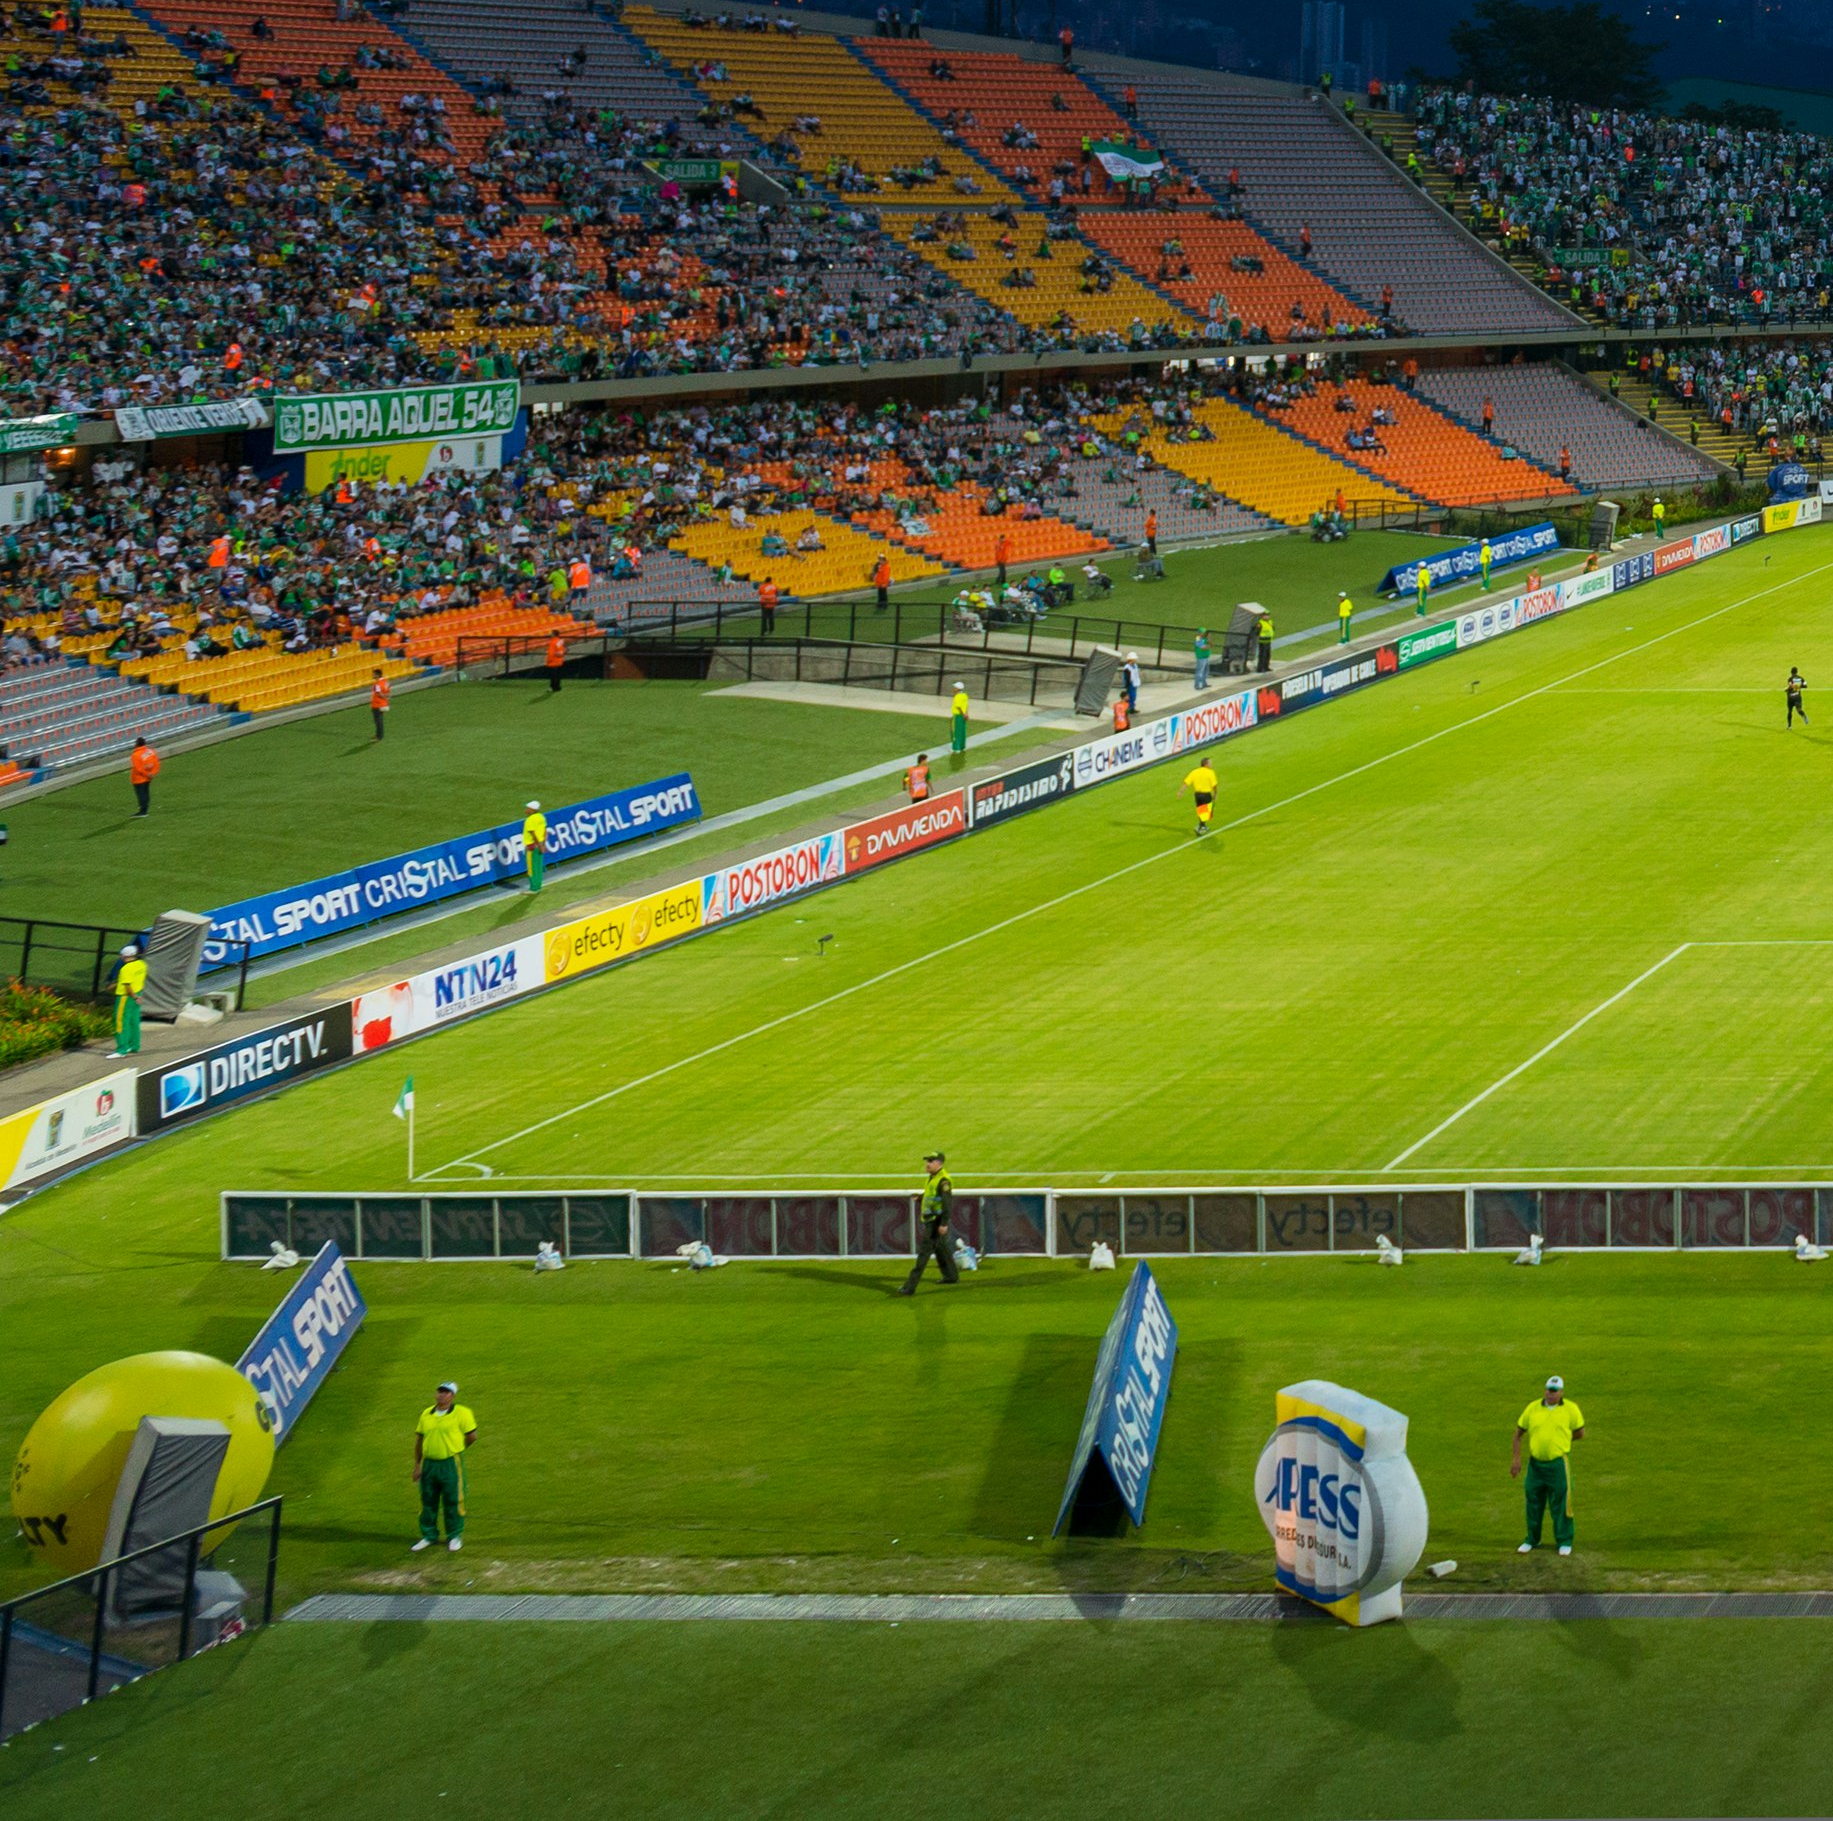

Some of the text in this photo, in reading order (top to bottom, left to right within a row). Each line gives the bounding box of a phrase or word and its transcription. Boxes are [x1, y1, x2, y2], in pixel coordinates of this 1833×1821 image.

[664, 163, 706, 177] SALIDA
[1564, 251, 1601, 263] SALIDA
[301, 389, 495, 441] BARRA AQUEL 54
[1783, 473, 1809, 486] SPORT
[1533, 527, 1558, 549] SPORT
[1523, 587, 1557, 620] POSTOBON
[1185, 699, 1243, 745] POSTOBON
[1095, 737, 1144, 773] CHANEME
[975, 774, 1059, 820] RAPIDISIMO
[866, 805, 963, 856] DAVIVIENDA
[273, 882, 362, 937] SPORT
[364, 855, 468, 908] CRISTAL
[466, 833, 526, 877] SPOR
[545, 805, 633, 854] CRISTAL
[629, 782, 693, 826] SPORT
[727, 844, 821, 913] POSTOBON
[574, 895, 700, 956] efecty efecty
[433, 948, 517, 1008] NTN24
[435, 982, 518, 1019] NUESTRA TELE NOTICIAS
[293, 1255, 359, 1369] SPORT
[1110, 1275, 1171, 1508] CRISTAL SPORT
